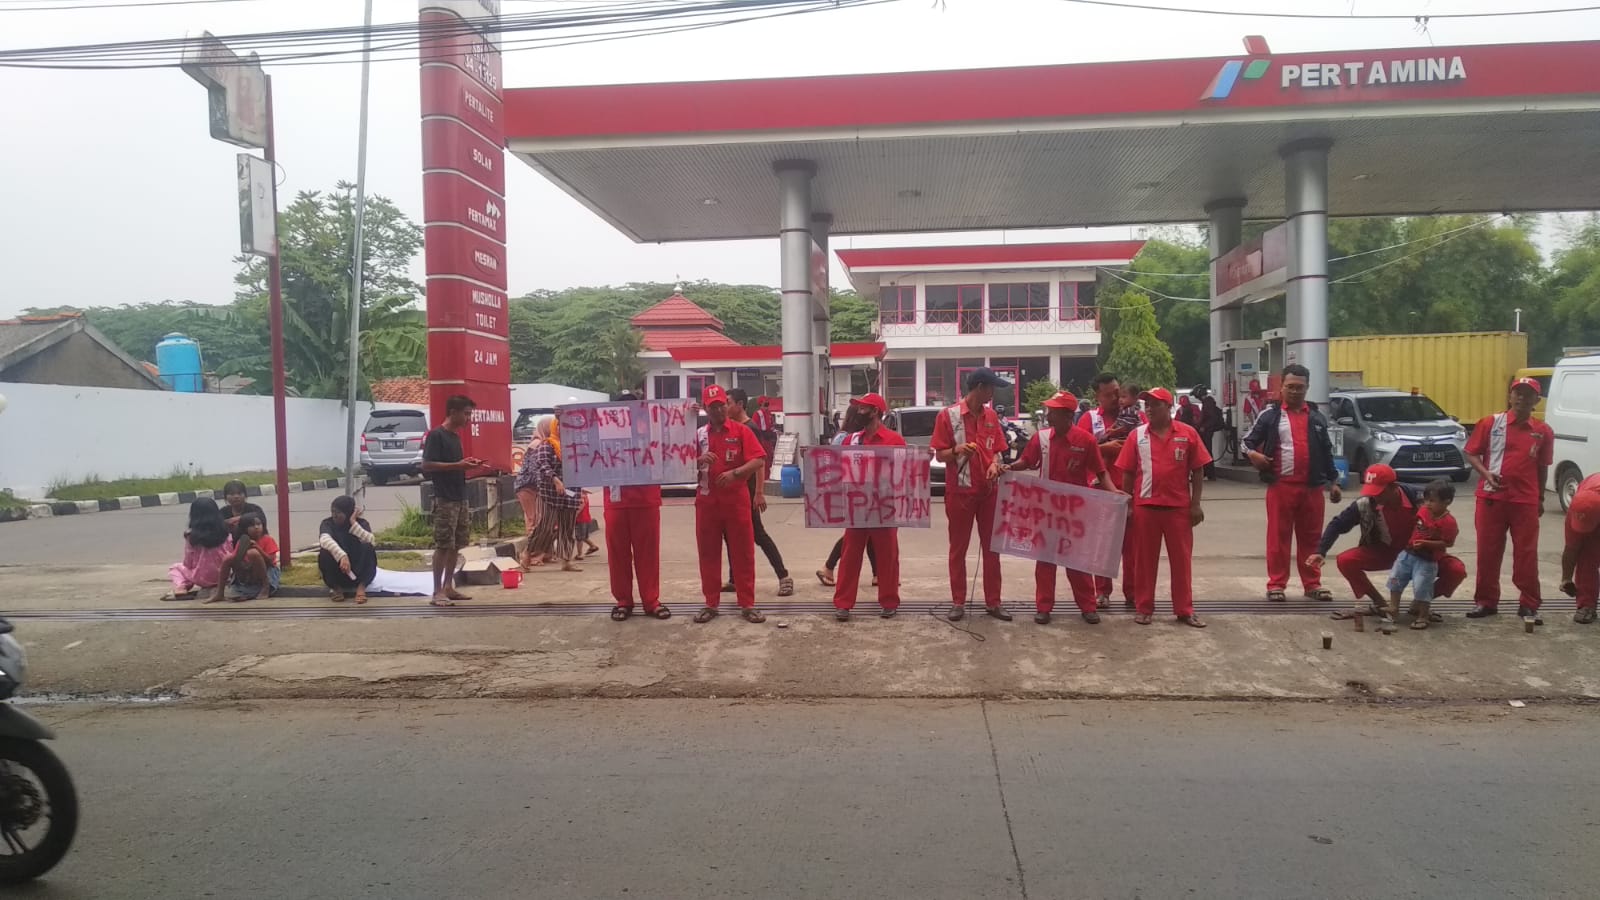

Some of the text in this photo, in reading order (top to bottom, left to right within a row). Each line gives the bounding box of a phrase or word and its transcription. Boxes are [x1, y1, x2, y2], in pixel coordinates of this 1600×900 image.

[1281, 56, 1467, 88] PERTAMINA
[465, 90, 494, 123] PERTALITE
[473, 148, 492, 170] SOLAR
[468, 207, 497, 231] PERTAMAX
[474, 250, 497, 270] MESRAN
[472, 289, 501, 310] MUSHOLLA
[475, 312, 497, 329] TOILET
[474, 350, 498, 366] 24 JAM
[470, 409, 505, 423] PERTAMINA
[566, 442, 656, 473] FAKTA
[810, 448, 929, 491] BUTUH
[805, 491, 930, 526] KEPASTIAN
